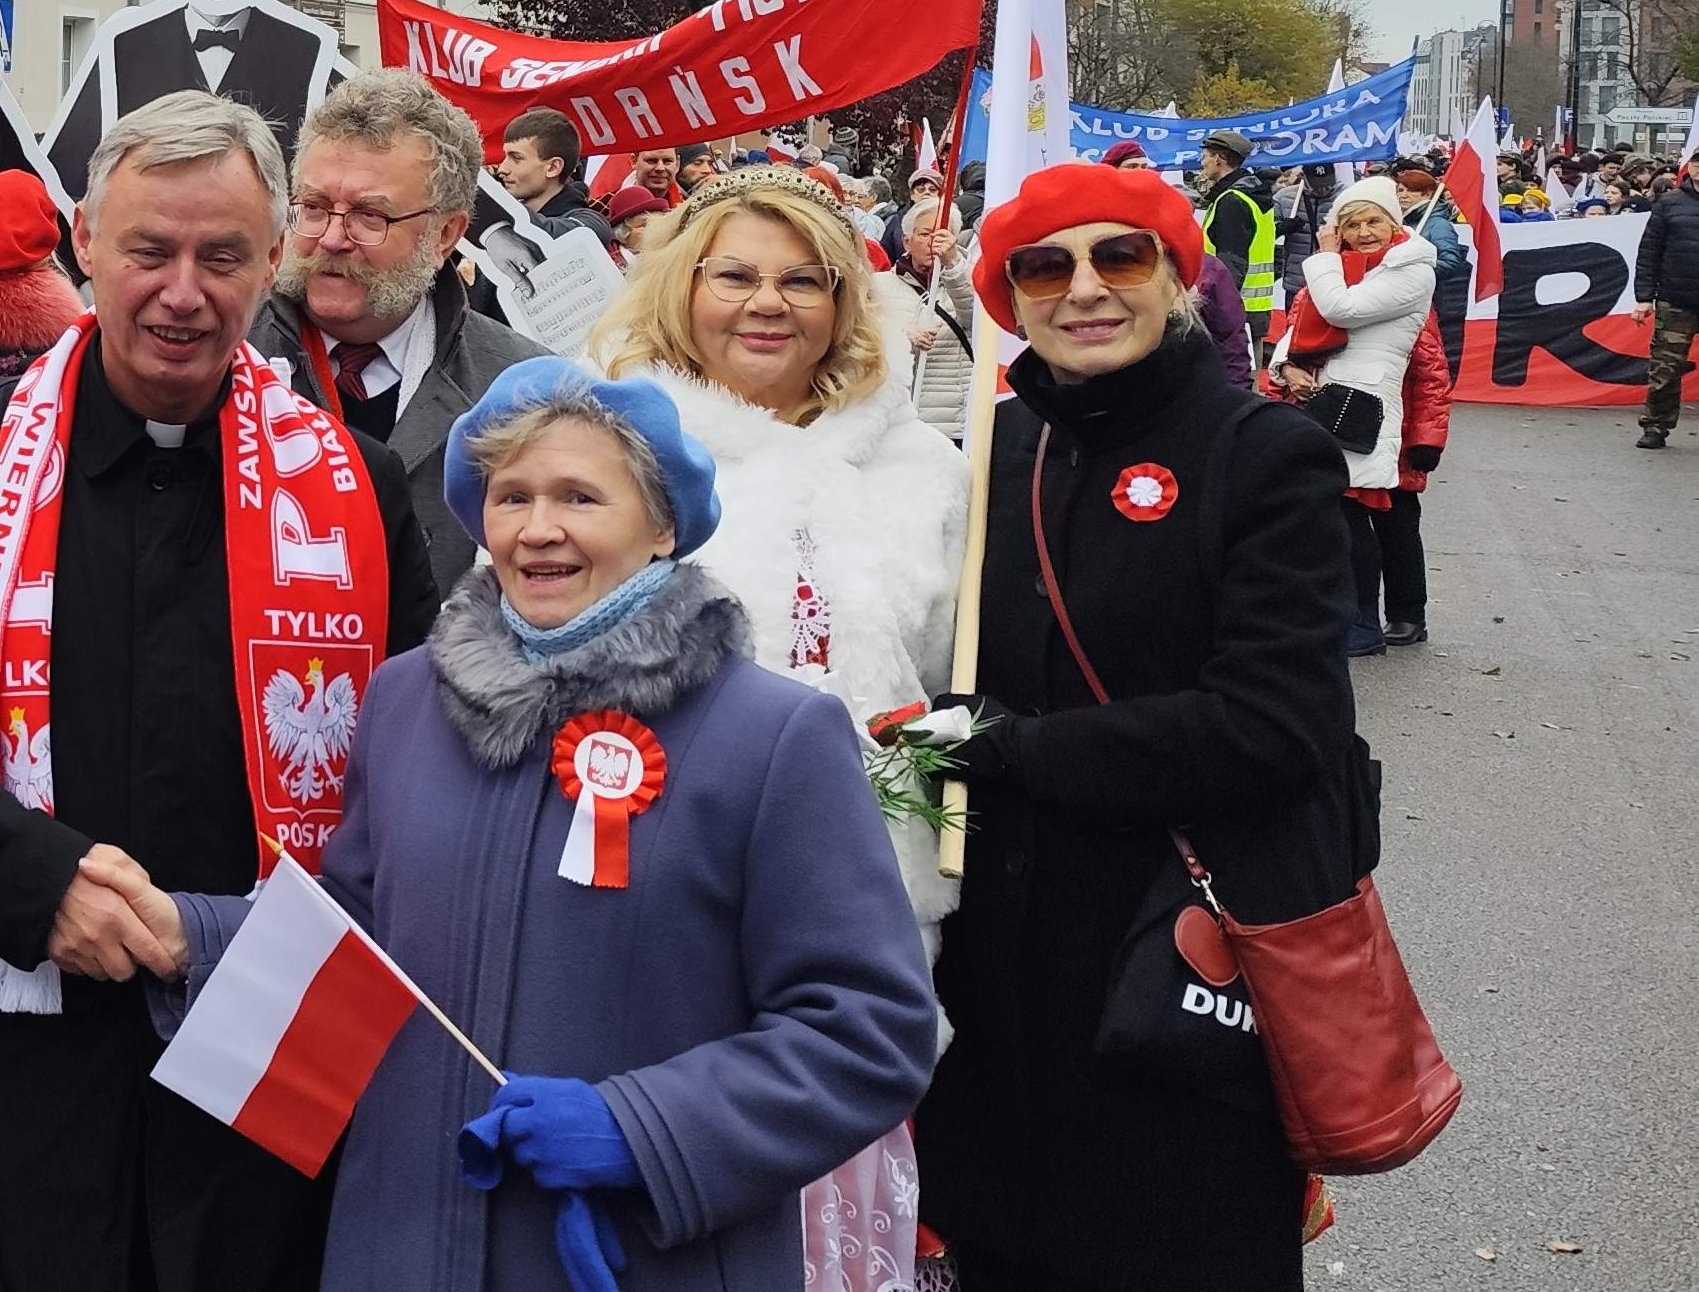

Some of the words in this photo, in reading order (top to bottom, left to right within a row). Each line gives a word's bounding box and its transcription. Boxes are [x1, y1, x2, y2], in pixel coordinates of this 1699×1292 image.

[403, 20, 498, 87] KLUB
[527, 33, 824, 147] DAŃSK
[291, 394, 357, 493] BIAŁO
[264, 609, 363, 639] TYLKO
